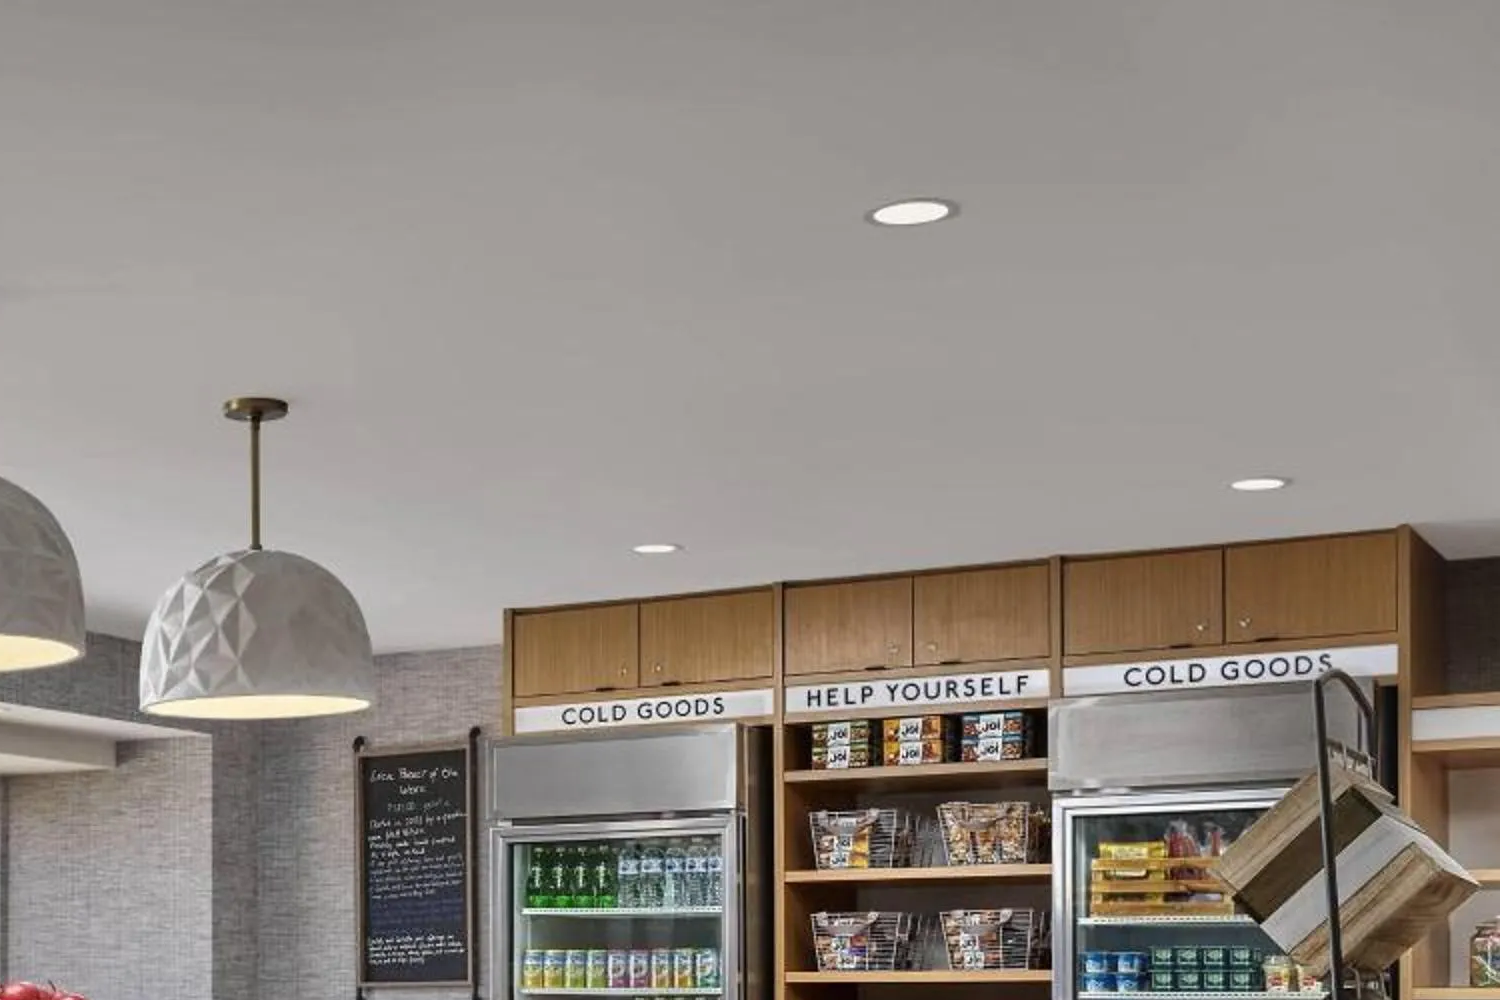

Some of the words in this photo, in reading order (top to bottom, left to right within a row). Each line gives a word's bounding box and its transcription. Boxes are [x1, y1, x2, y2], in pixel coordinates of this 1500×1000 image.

[1123, 662, 1206, 687] COLD
[1220, 653, 1333, 681] GOODS
[806, 685, 874, 707] HELP
[885, 675, 1029, 701] YOURSELF
[561, 705, 627, 725] COLD
[637, 697, 725, 719] GOODS
